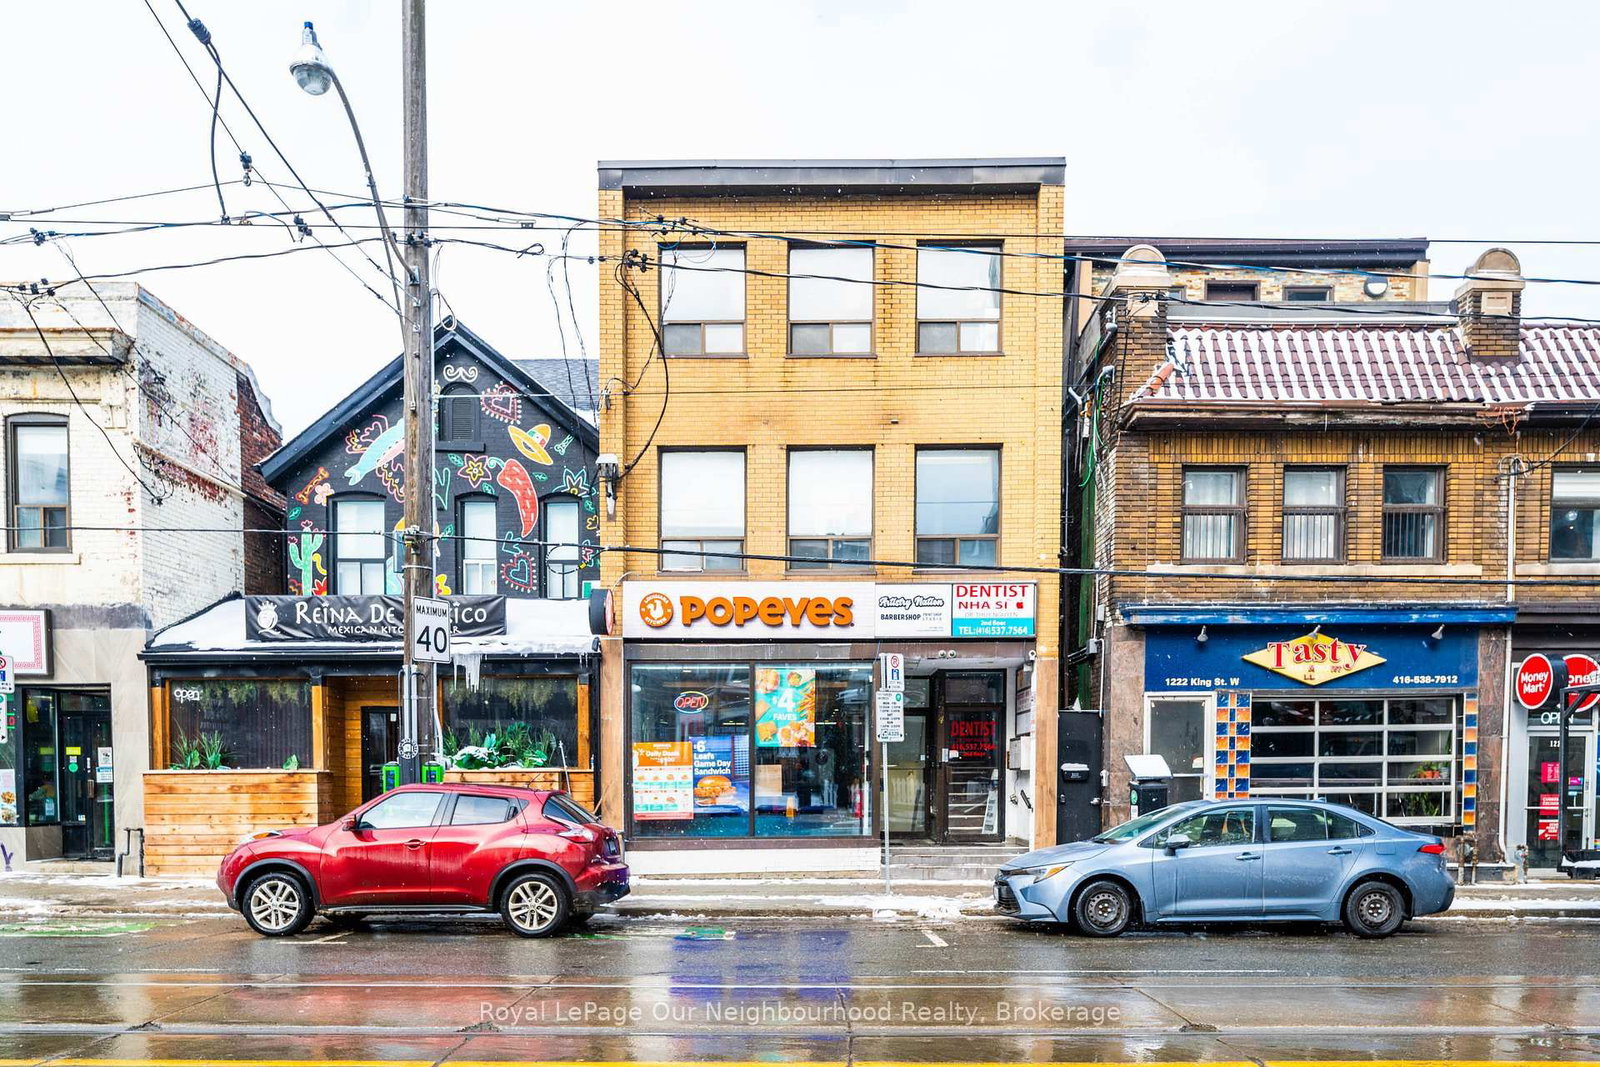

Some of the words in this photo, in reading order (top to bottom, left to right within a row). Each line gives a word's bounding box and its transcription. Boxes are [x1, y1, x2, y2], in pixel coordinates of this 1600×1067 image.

[956, 585, 1028, 597] DENTIST
[416, 604, 448, 618] MAXIMUM
[328, 627, 376, 635] MEXICAN
[382, 625, 404, 634] KITC
[416, 626, 448, 653] 40
[1267, 638, 1367, 670] Tasty
[1165, 678, 1188, 686] 1222
[1190, 678, 1212, 688] King
[1214, 678, 1228, 686] St.
[1230, 678, 1240, 686] W
[1393, 675, 1458, 684] 416-538-7912
[1520, 671, 1549, 684] Money
[1523, 683, 1543, 693] Mart
[174, 689, 200, 703] open
[676, 695, 704, 709] OPEN
[774, 713, 797, 721] FAVES
[951, 719, 996, 736] DENTIST
[694, 760, 715, 768] Game
[717, 760, 731, 768] Day
